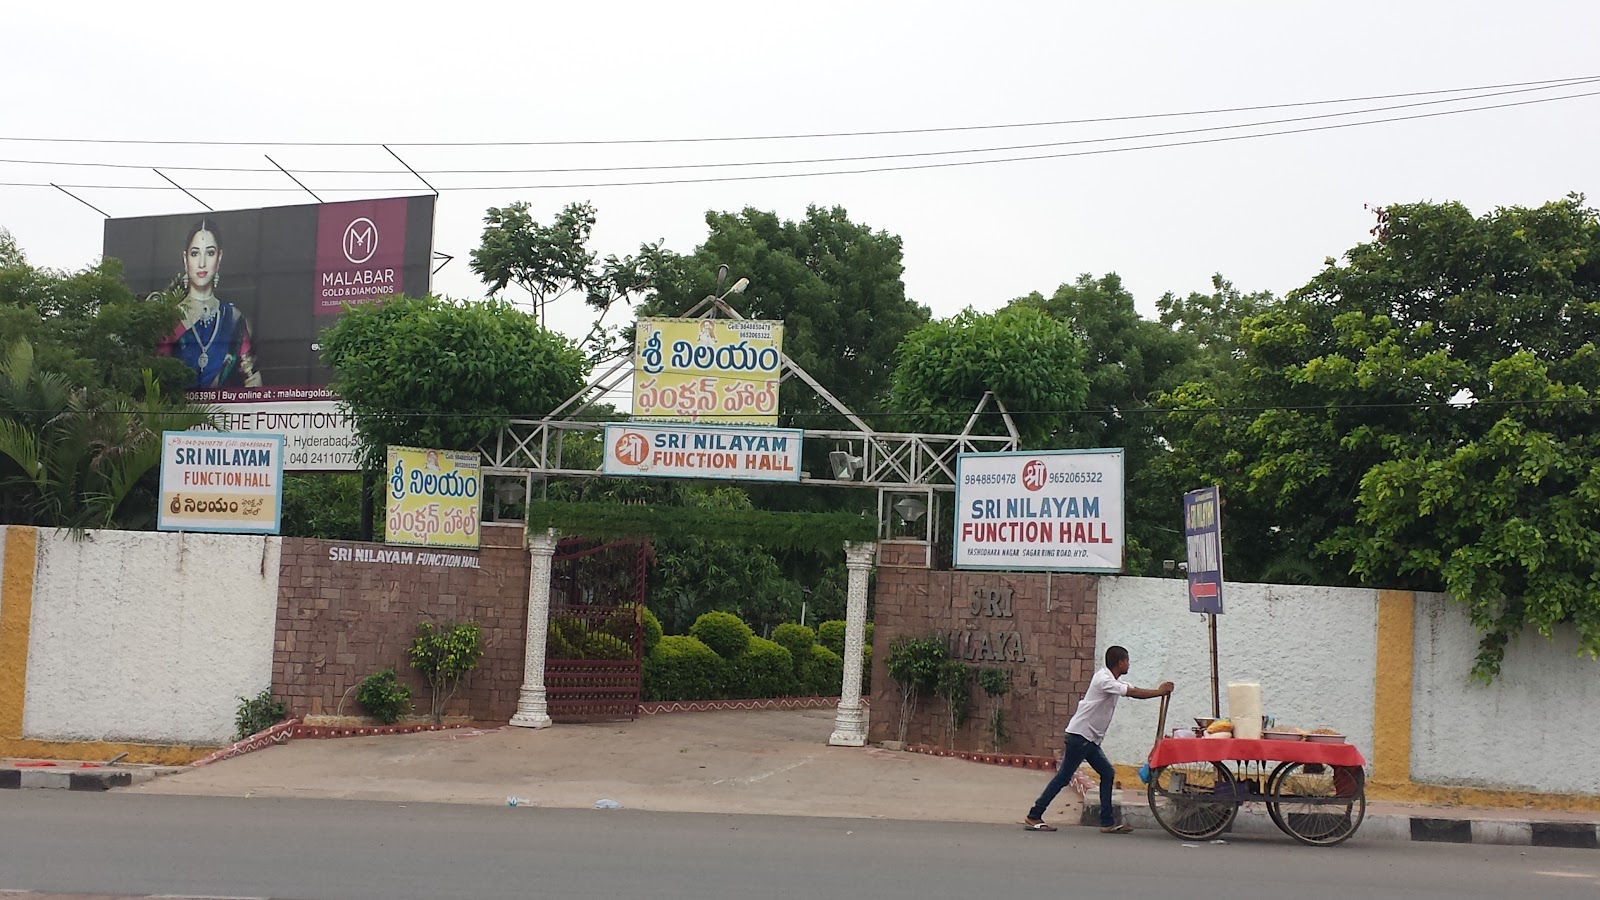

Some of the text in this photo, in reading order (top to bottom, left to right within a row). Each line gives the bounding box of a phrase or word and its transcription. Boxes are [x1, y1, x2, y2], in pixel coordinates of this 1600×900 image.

[322, 269, 394, 286] MALABAR
[322, 285, 394, 297] GOLD & DIAMONDS
[671, 340, 778, 371] నిలయం
[222, 391, 237, 401] Buy
[238, 390, 262, 399] online
[723, 381, 778, 413] హాల్
[256, 411, 337, 430] FUNCTION
[654, 433, 787, 452] SRI NILAYAM
[175, 448, 201, 465] SRI
[206, 449, 271, 467] NILAYAM
[289, 452, 308, 464] 040
[653, 451, 794, 471] FUNCTION HALL
[184, 471, 271, 487] FUNCTION HALL
[410, 470, 477, 497] నిలయం
[965, 474, 1016, 485] 9848850478
[1049, 472, 1103, 483] 9652065322
[184, 498, 239, 513] నిలయం
[972, 497, 1100, 519] SRI NILAYAM
[444, 506, 477, 535] హాల్
[962, 521, 1113, 544] FUNCTION HALL
[328, 546, 481, 569] SRI NILAYAM FUNCTION HALL
[1002, 548, 1020, 557] NAGAR
[1022, 549, 1040, 557] SAGAR
[1041, 549, 1055, 557] RING
[971, 588, 1014, 618] SRI
